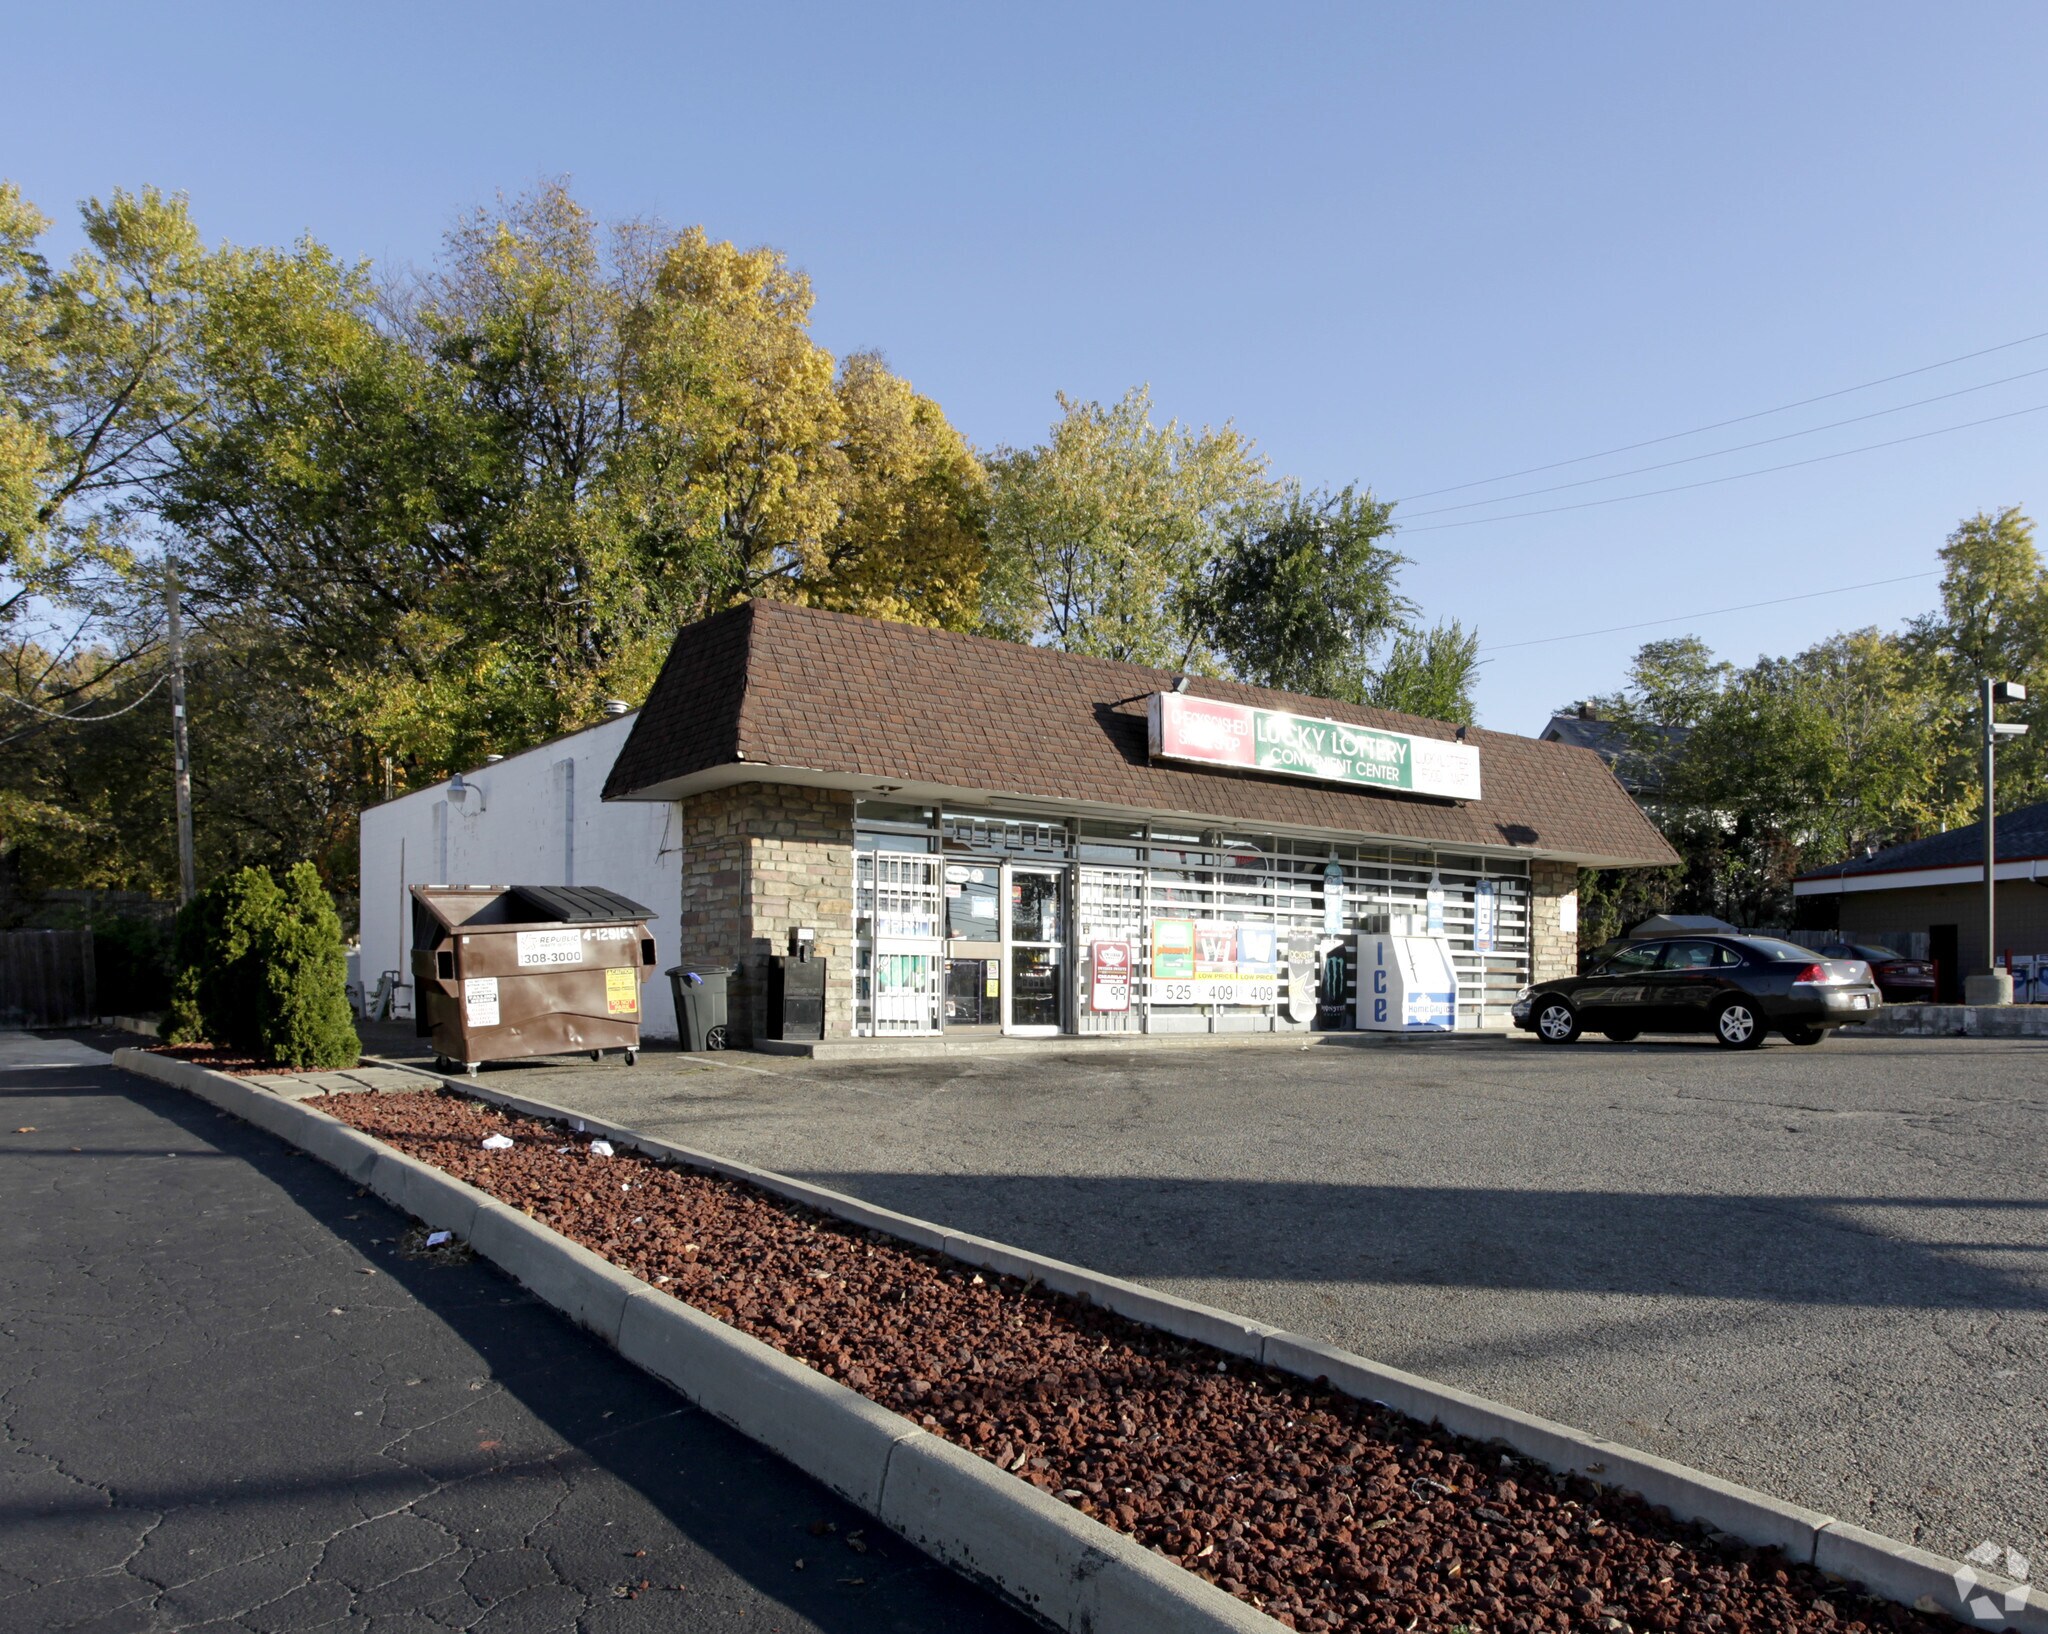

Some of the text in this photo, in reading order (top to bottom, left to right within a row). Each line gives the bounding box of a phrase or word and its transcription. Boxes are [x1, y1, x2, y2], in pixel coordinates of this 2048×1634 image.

[1256, 717, 1408, 765] LUCKY LOTTERY
[1270, 747, 1400, 782] CONVENIENT CENTER
[539, 934, 579, 944] REPUBLIC
[524, 951, 581, 964] 308-3000
[1110, 986, 1127, 1001] 99
[1166, 984, 1191, 1000] 525
[1209, 985, 1233, 1000] 409
[1250, 986, 1273, 1001] 409
[1408, 1004, 1428, 1014] Home
